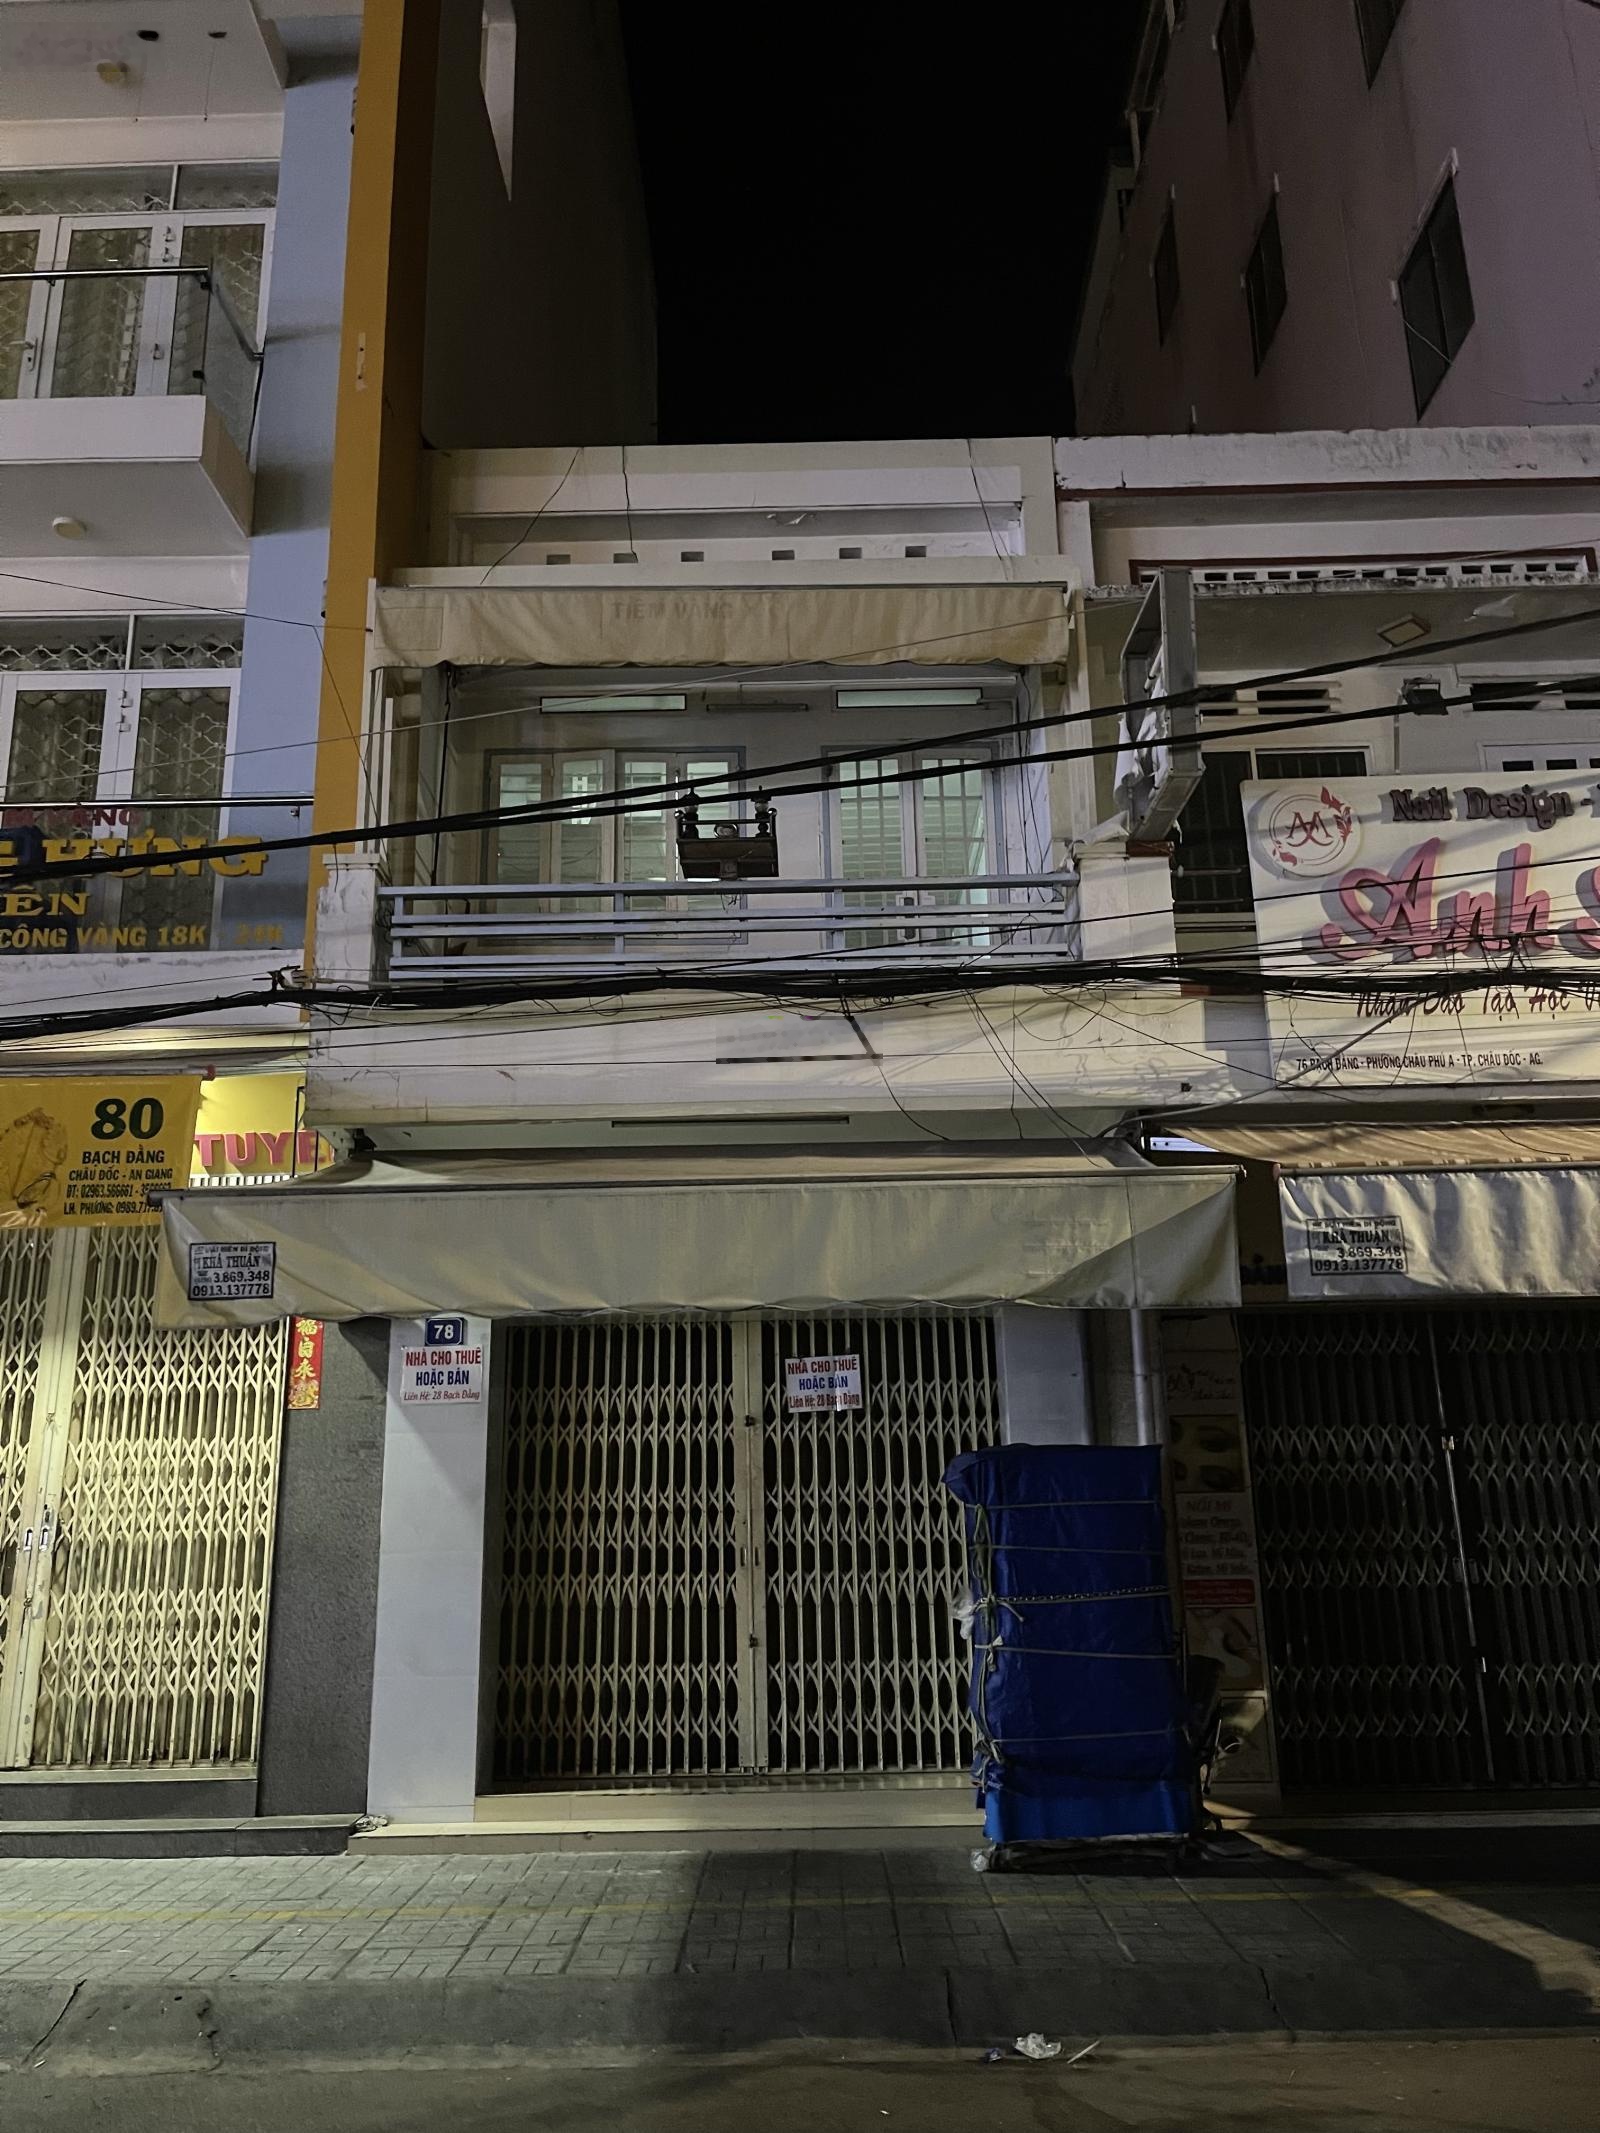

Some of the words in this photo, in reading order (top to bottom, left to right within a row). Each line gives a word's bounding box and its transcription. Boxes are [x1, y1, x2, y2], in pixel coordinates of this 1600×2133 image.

[1389, 786, 1452, 822] Nail
[1463, 784, 1575, 830] Design
[0, 885, 91, 916] ÊN
[0, 923, 68, 949] CÔNG
[76, 921, 147, 948] VÀNG
[158, 925, 207, 947] 18K
[1296, 1058, 1308, 1071] 76
[1448, 1054, 1455, 1068] A
[90, 1097, 164, 1140] 80
[82, 1150, 121, 1167] BẠCH
[128, 1169, 143, 1181] AN
[145, 1168, 173, 1180] GIANG
[1315, 1258, 1405, 1272] 0913.137778
[213, 1270, 270, 1283] 3.869.348
[192, 1283, 270, 1296] 0913.137778
[434, 1324, 454, 1341] 78
[406, 1348, 428, 1366] NHÀ
[431, 1350, 452, 1365] CHO
[455, 1347, 482, 1365] THUÊ
[811, 1360, 831, 1373] CHO
[416, 1368, 444, 1389] HOẶC
[799, 1375, 826, 1392] HOẶC
[432, 1390, 442, 1400] 28
